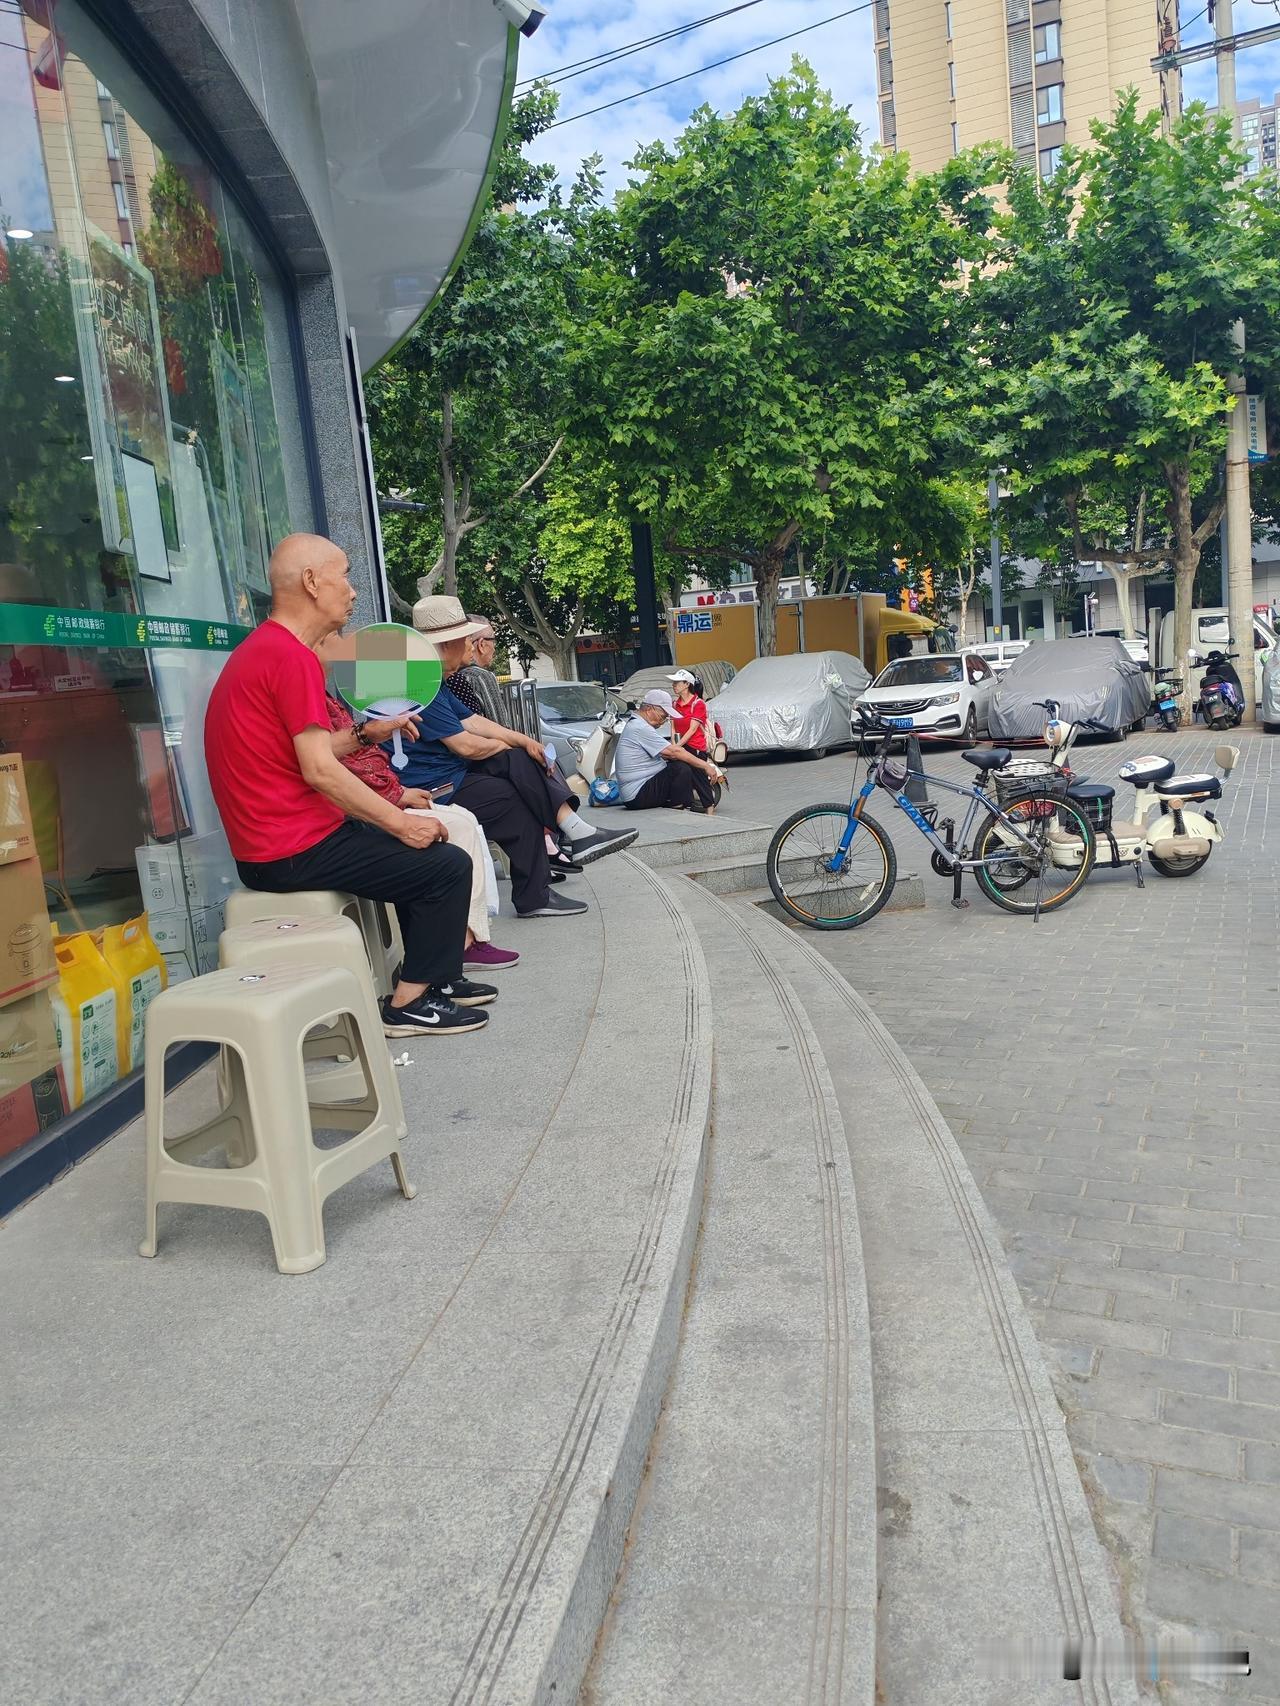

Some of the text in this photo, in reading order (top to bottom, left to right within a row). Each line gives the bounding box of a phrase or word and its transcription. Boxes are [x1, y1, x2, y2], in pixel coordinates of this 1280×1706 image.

[57, 615, 105, 630] 中国邮政储蓄银行
[147, 620, 191, 636] 中国邮政储蓄银行
[677, 612, 712, 633] 鼎运
[898, 796, 935, 834] GIANT
